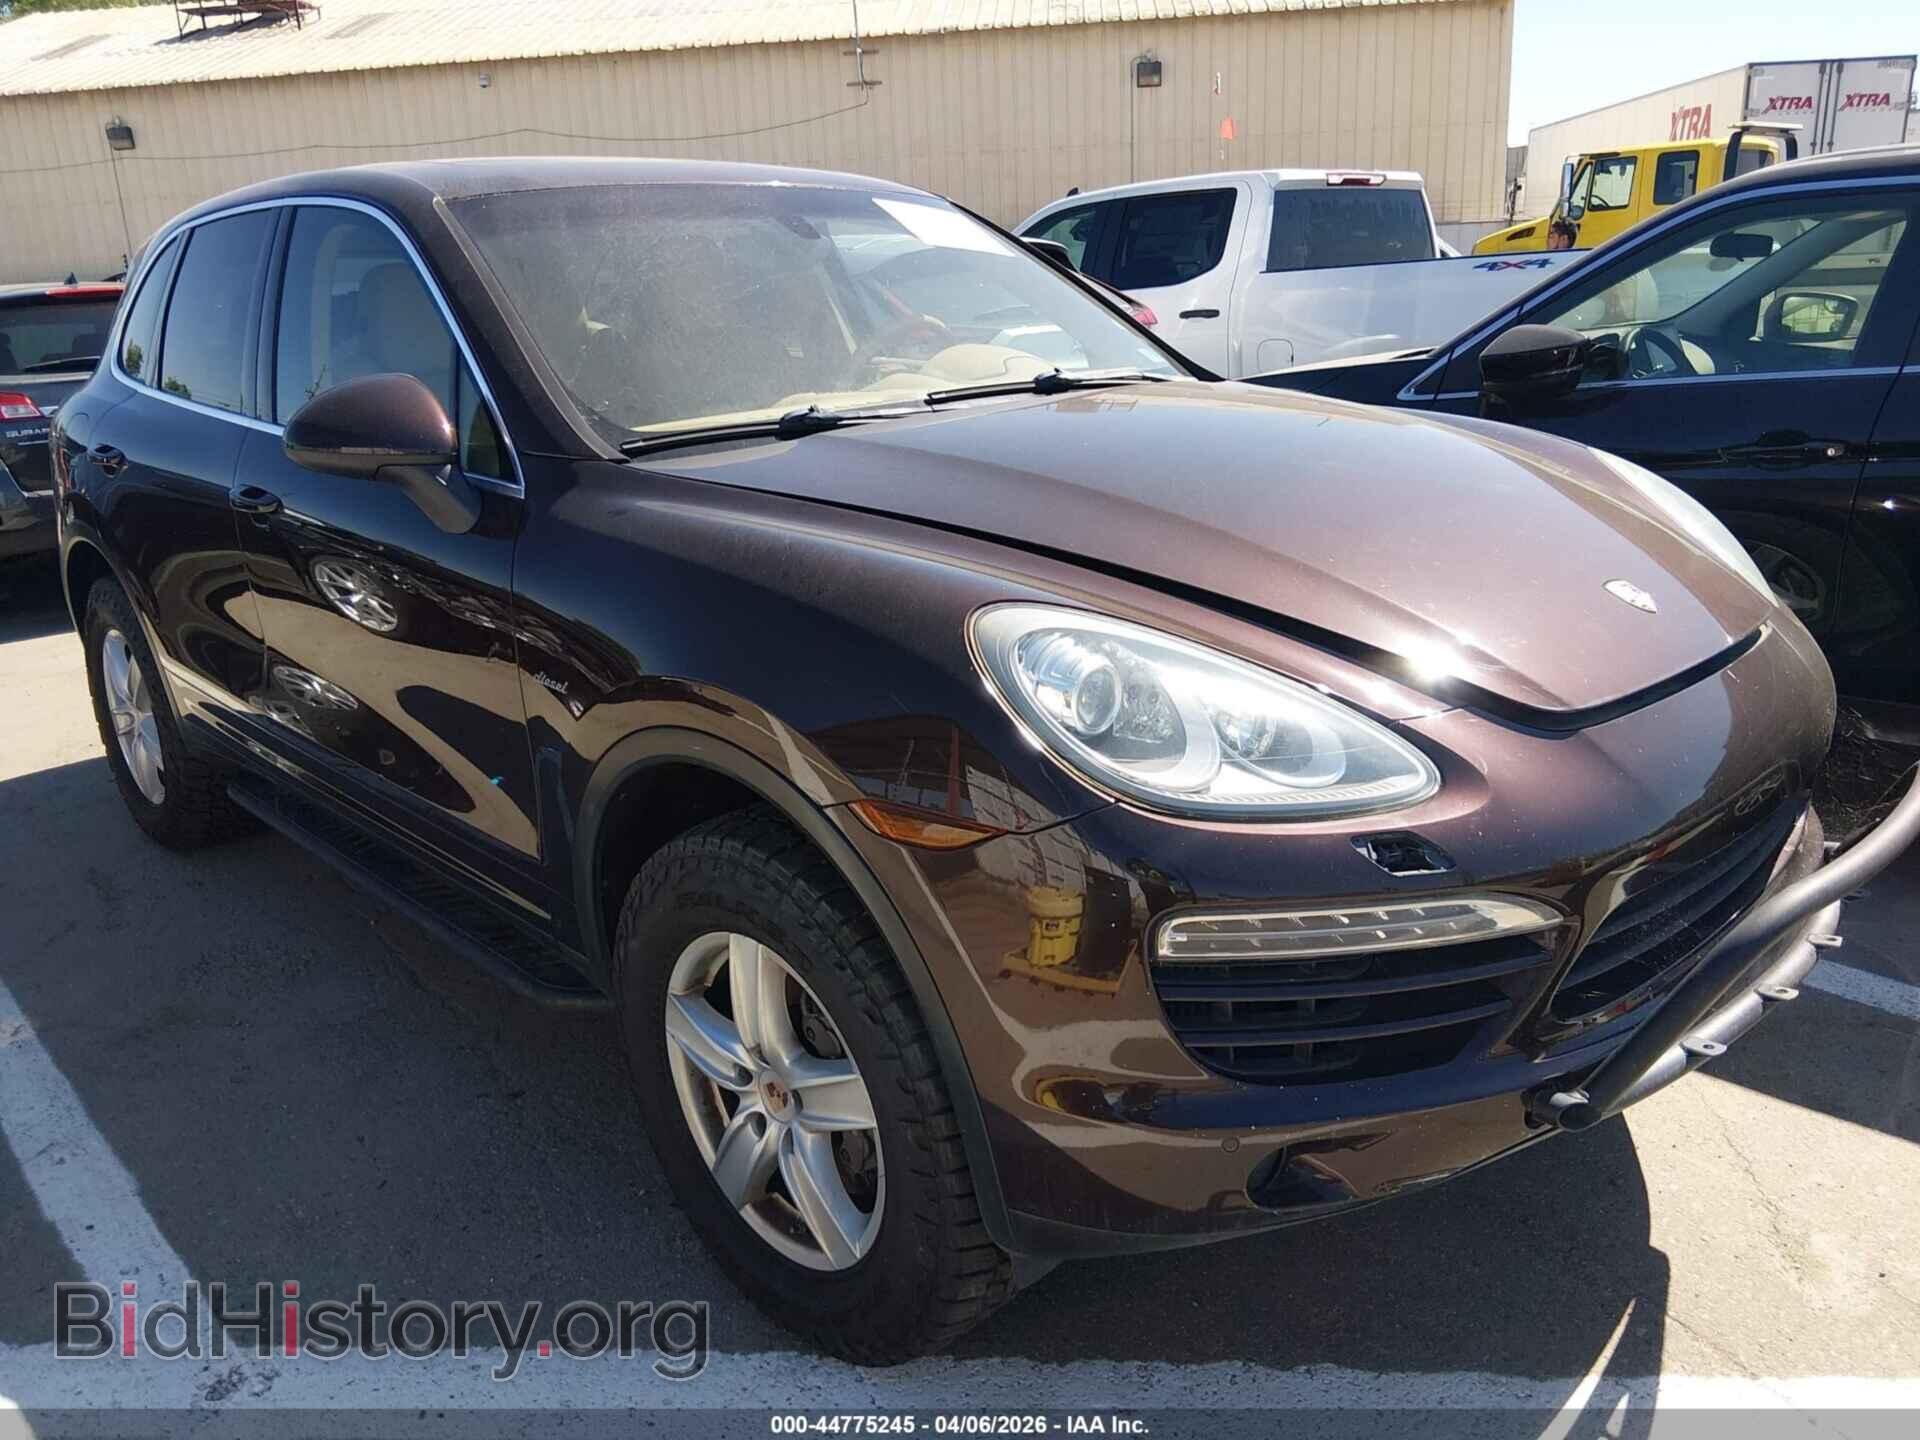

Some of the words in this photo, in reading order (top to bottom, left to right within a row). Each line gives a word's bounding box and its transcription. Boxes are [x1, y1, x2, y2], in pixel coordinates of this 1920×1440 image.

[1761, 96, 1813, 115] XTRA
[1838, 93, 1892, 112] XTRA
[1669, 103, 1711, 141] XTRA
